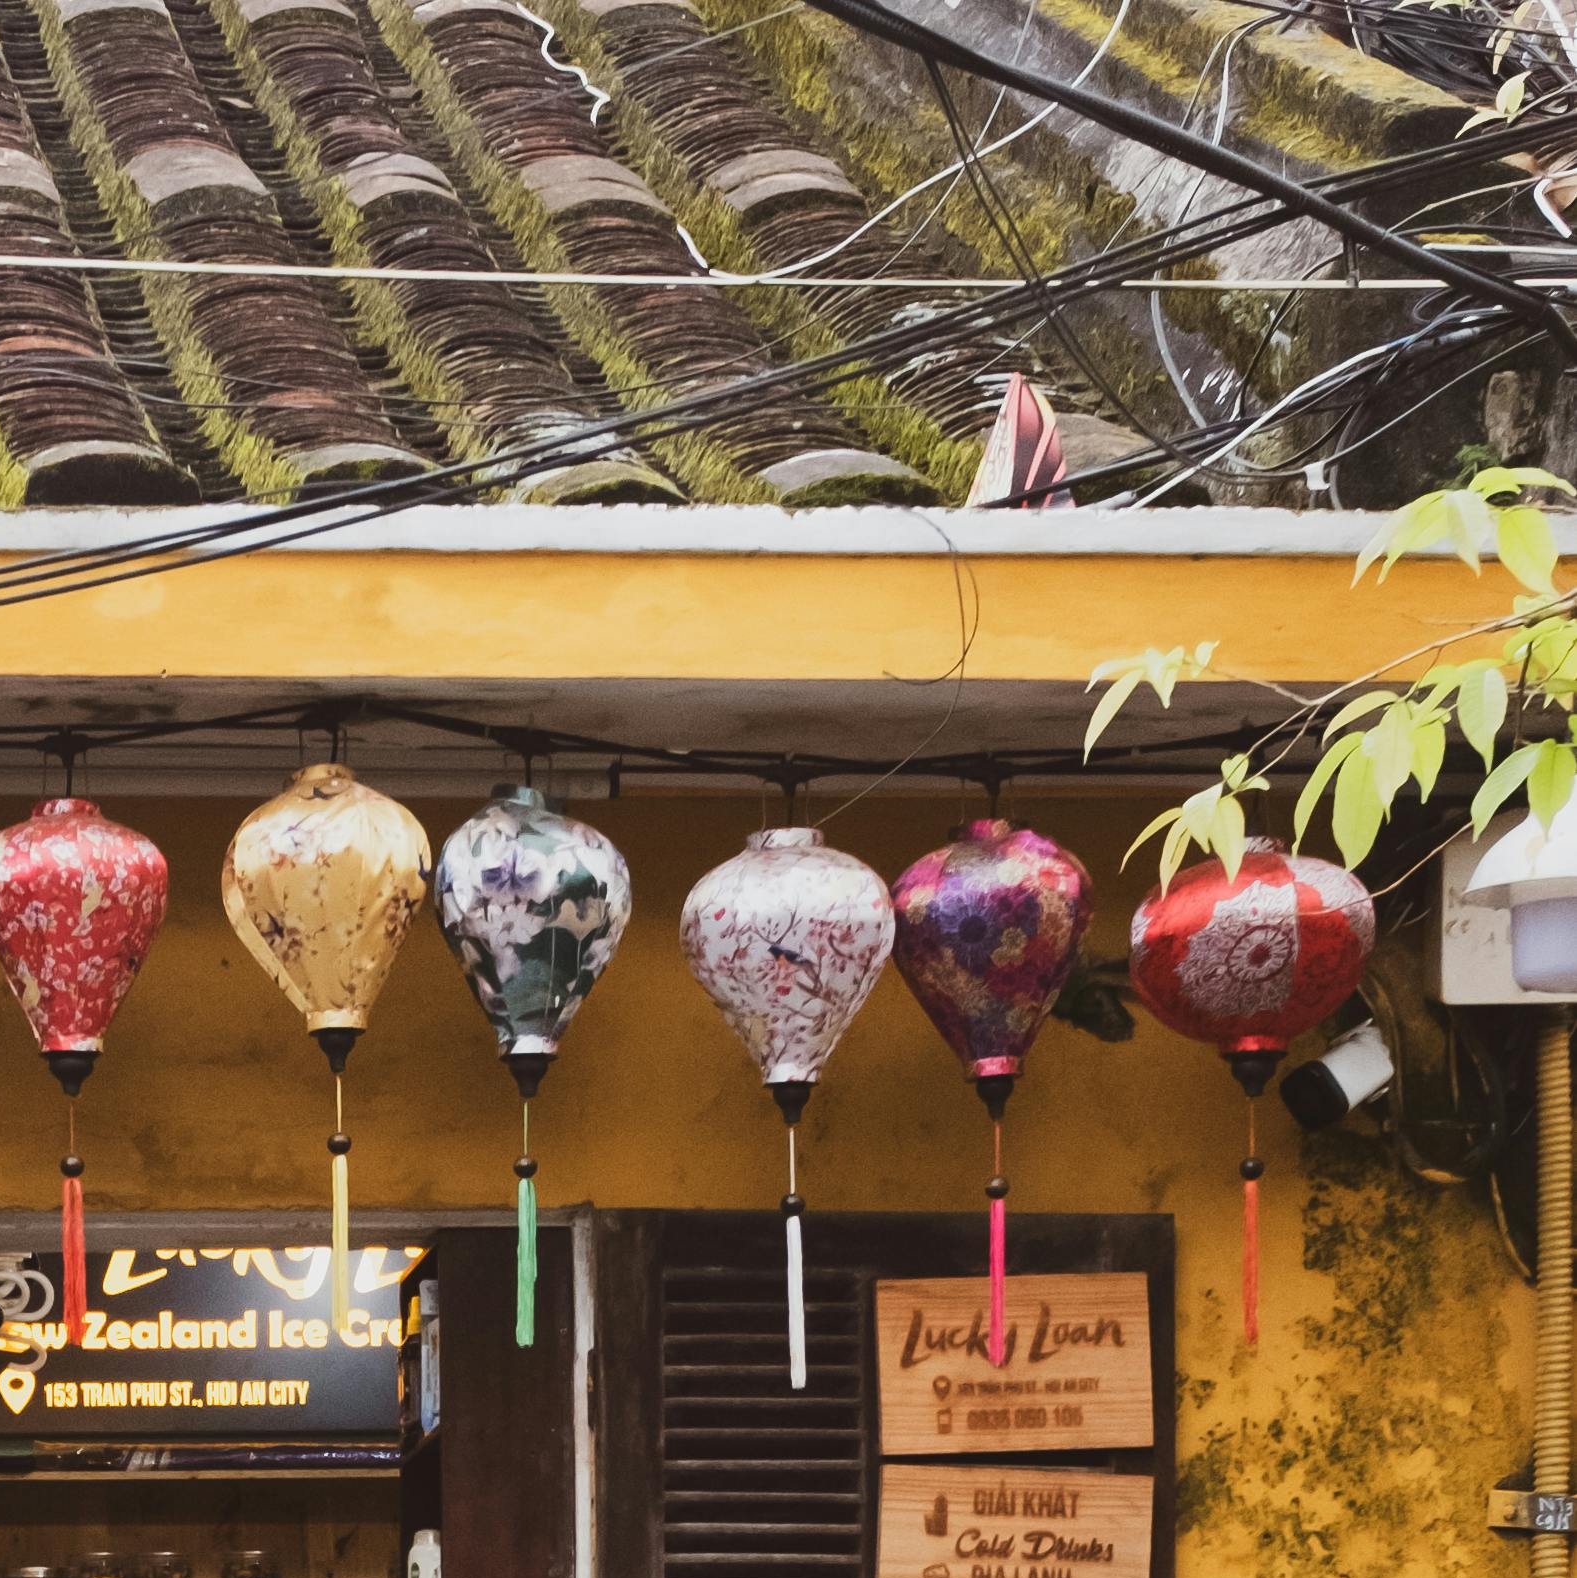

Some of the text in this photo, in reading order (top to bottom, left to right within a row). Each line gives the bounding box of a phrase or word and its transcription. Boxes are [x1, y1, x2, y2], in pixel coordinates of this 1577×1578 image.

[81, 1310, 258, 1350] Zealand
[269, 1310, 329, 1349] Ice
[899, 1302, 1126, 1369] Lucky Loan
[44, 1383, 78, 1408] 153
[81, 1382, 128, 1408] TRAN
[130, 1382, 168, 1407] PHU
[206, 1381, 238, 1407] HOI
[240, 1381, 267, 1406] AN
[268, 1380, 310, 1406] CITY
[955, 1528, 1114, 1562] Cold Drinks
